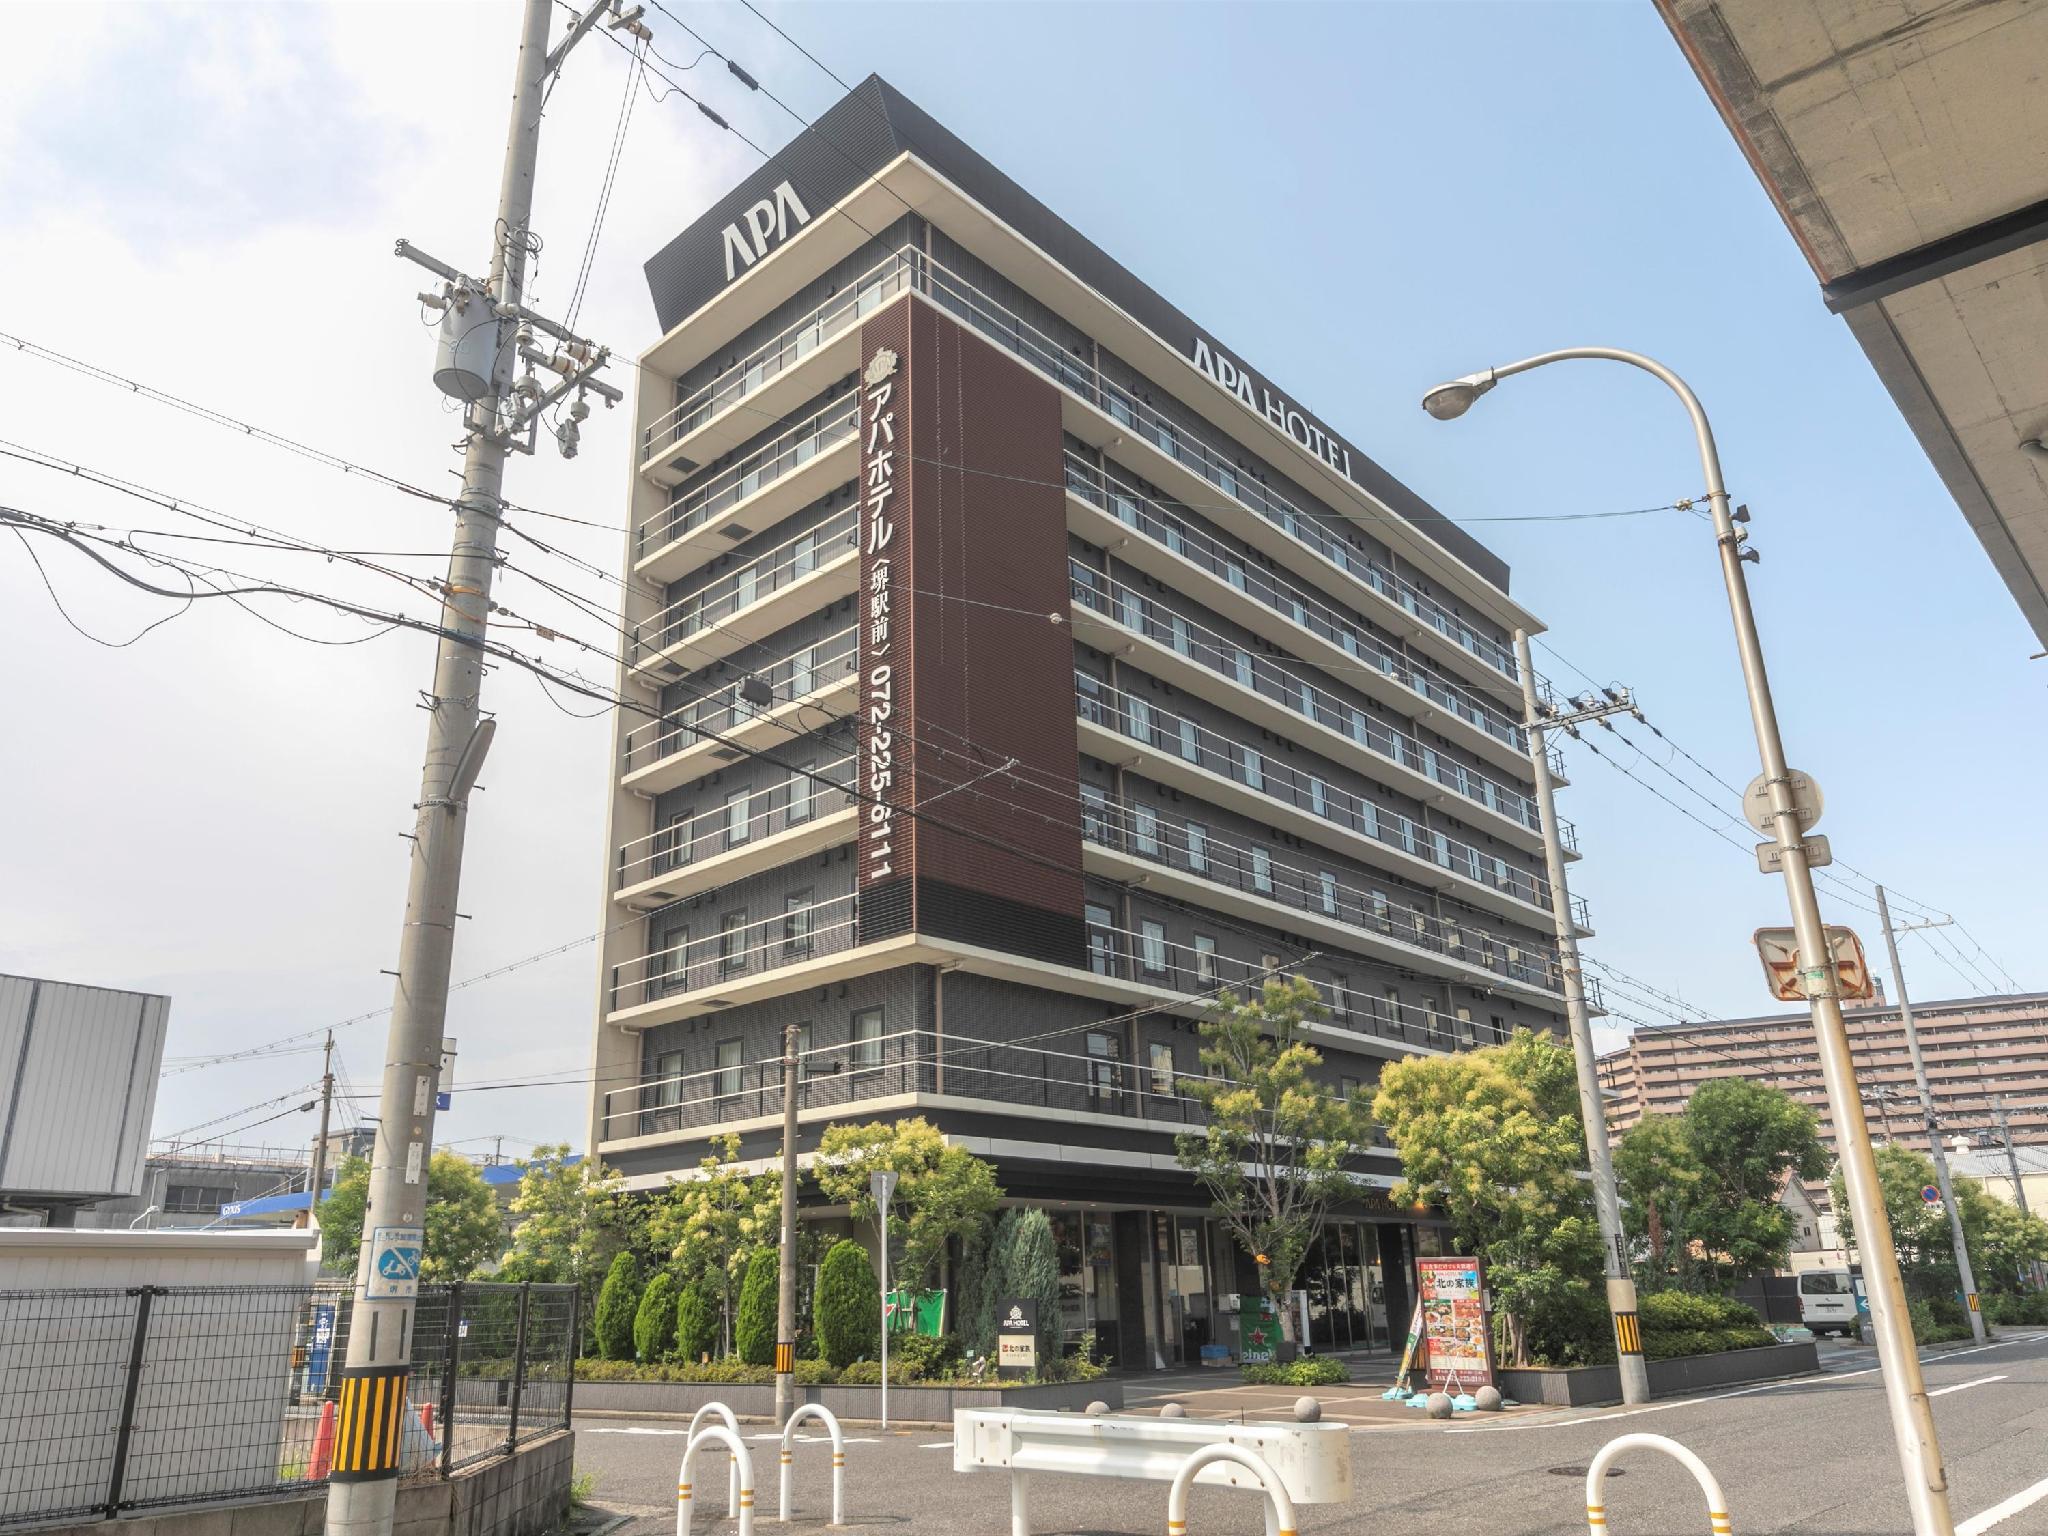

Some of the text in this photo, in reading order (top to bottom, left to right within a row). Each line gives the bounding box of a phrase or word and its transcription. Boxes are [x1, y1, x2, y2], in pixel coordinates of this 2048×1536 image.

[721, 180, 811, 282] APA
[1194, 337, 1352, 480] APA HOTEL
[871, 665, 892, 879] 072-225-6111
[1436, 1278, 1475, 1289] 北の家族
